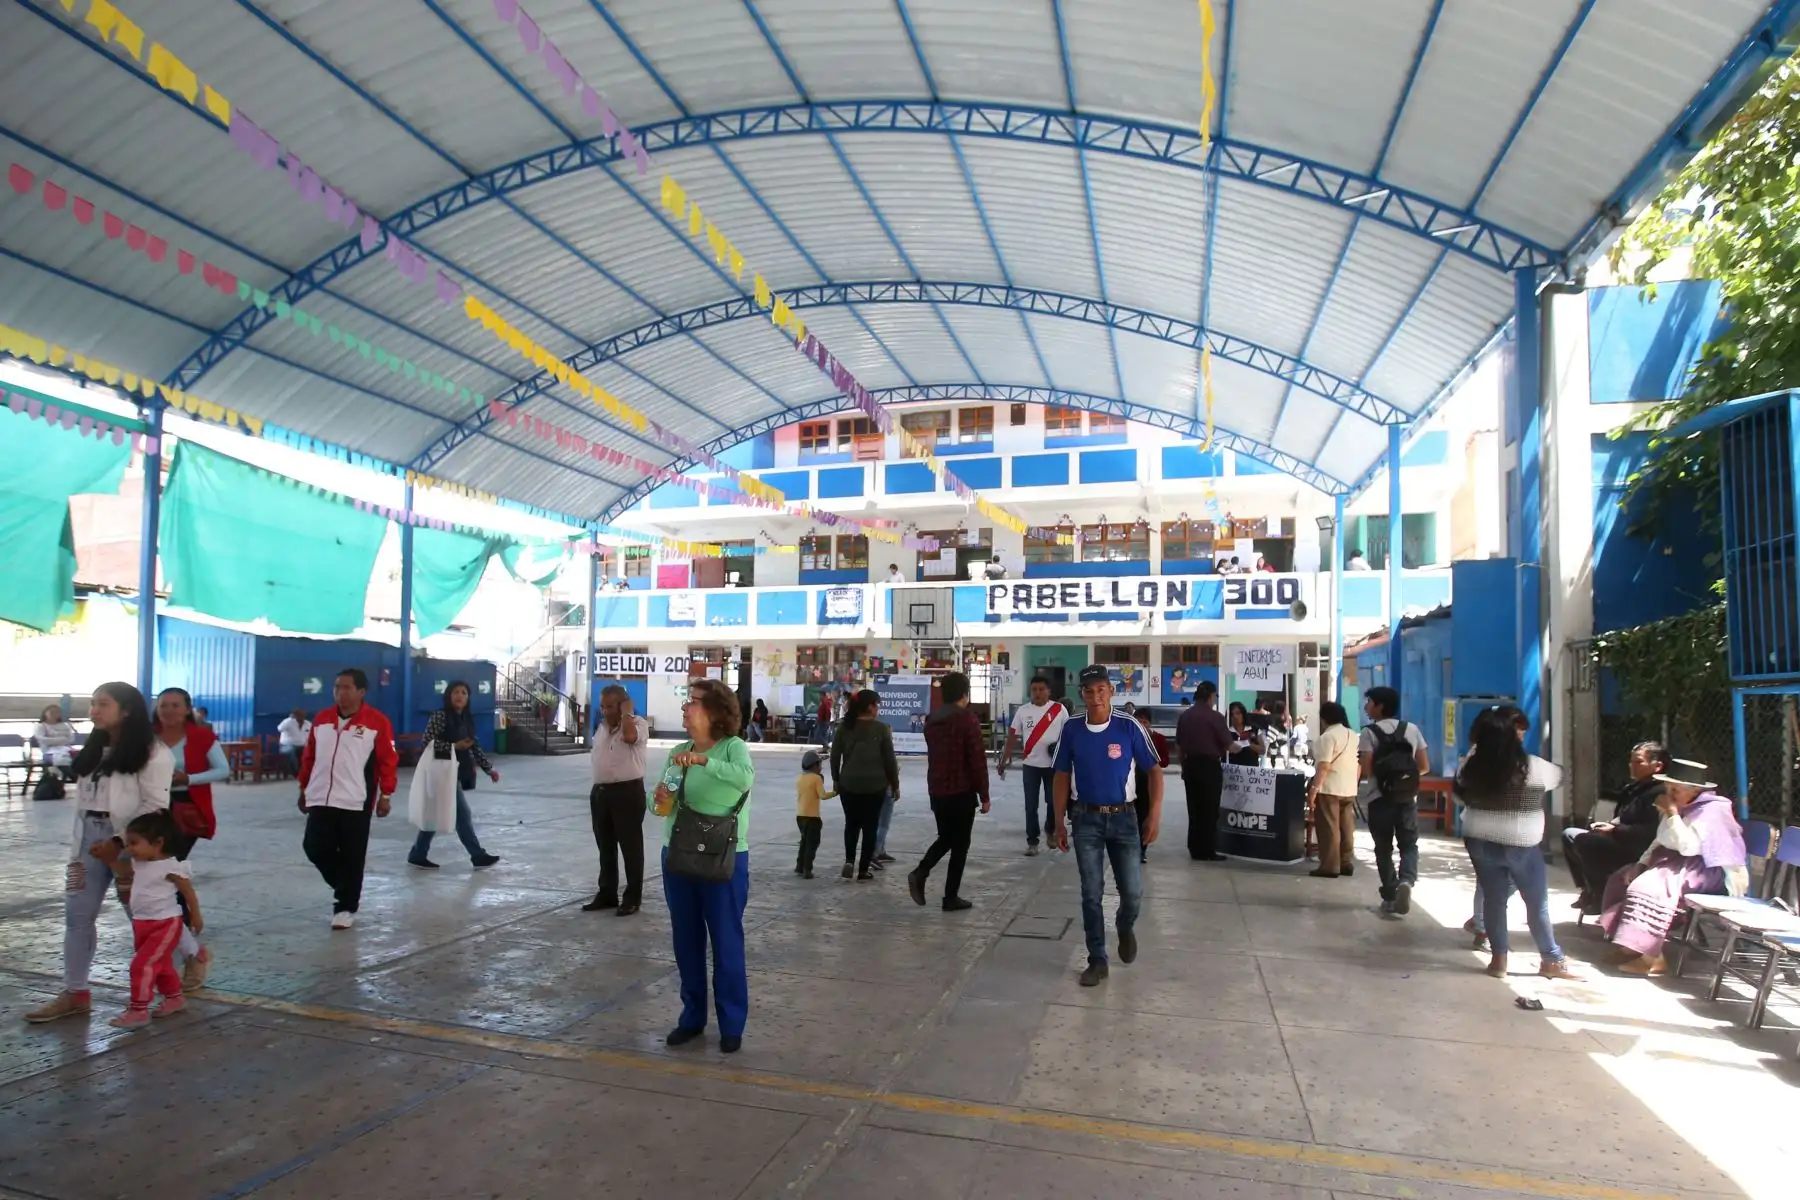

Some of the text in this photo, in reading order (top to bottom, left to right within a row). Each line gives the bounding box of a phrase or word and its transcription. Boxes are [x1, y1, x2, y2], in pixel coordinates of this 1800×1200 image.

[989, 578, 1300, 610] PABELLON 300
[1237, 649, 1282, 664] INFORMES
[1227, 812, 1268, 830] ONPE
